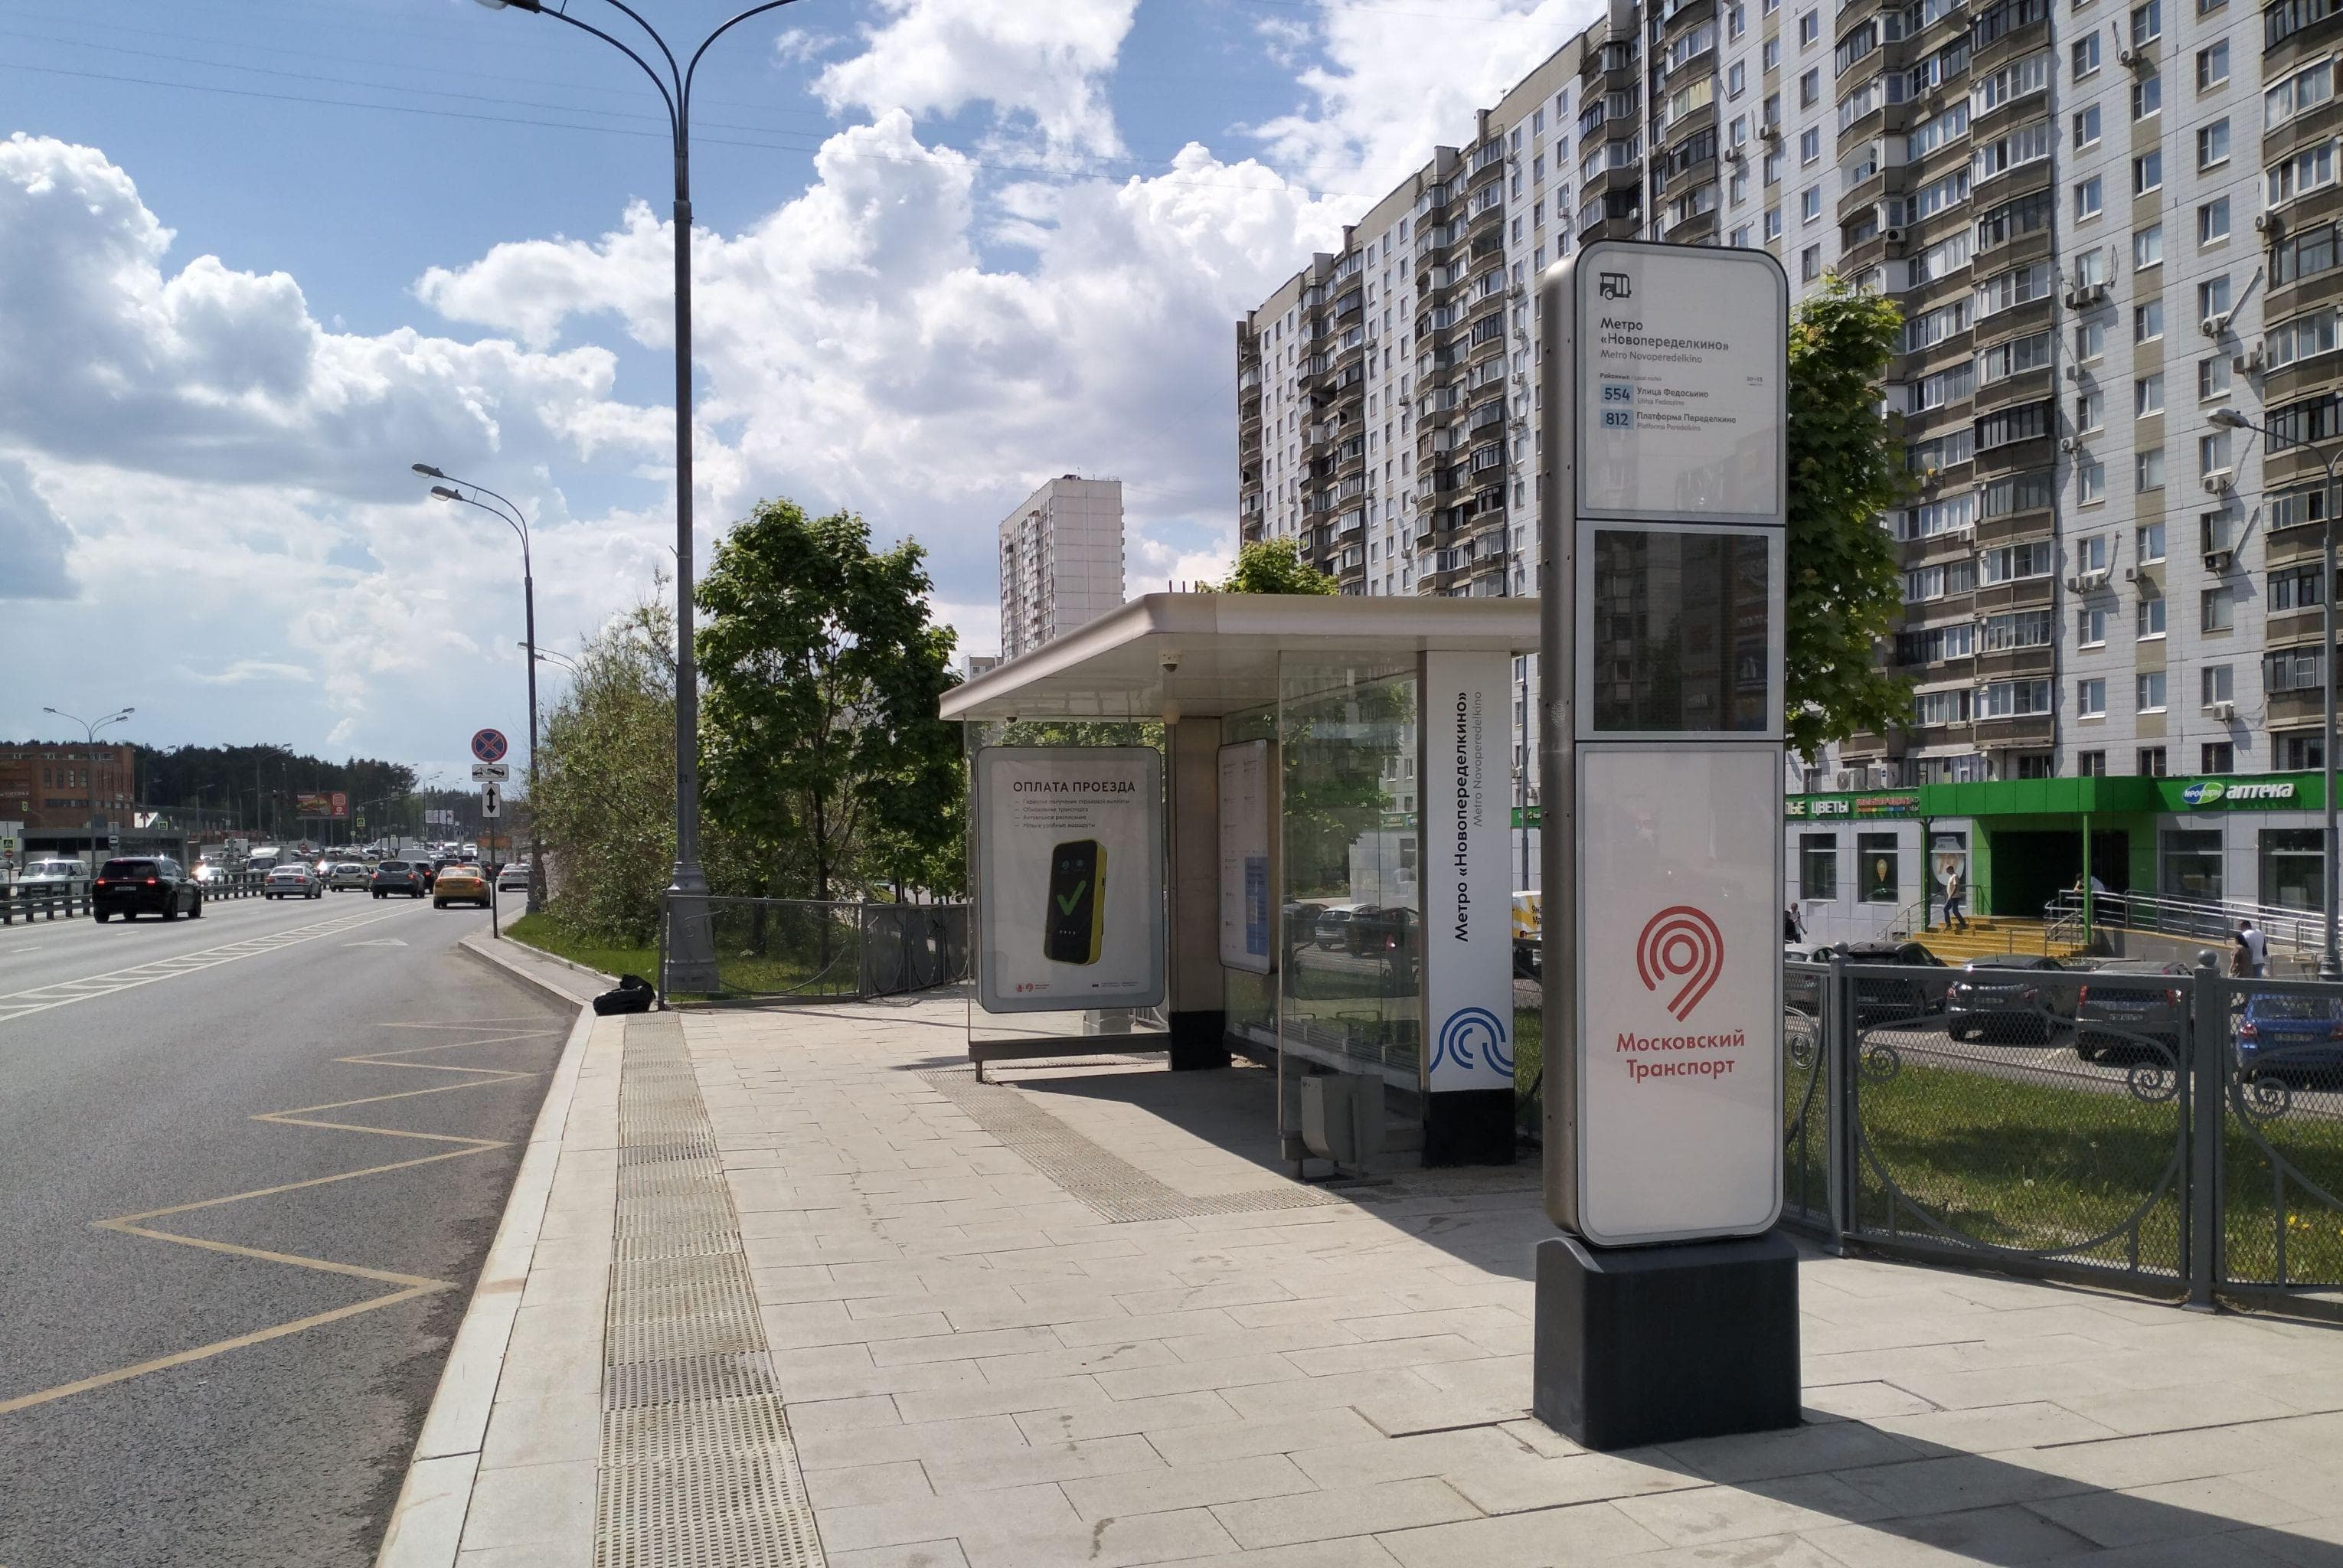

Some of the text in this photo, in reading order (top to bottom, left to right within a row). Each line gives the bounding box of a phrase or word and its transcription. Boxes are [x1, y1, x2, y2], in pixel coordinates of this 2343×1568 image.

[1600, 317, 1643, 332] Метро
[1600, 332, 1729, 351] «Новопеределкино»
[1600, 350, 1702, 363] Metro Novoperedelkino
[1605, 387, 1630, 400] 554
[1637, 387, 1708, 397] Улица Федосьино
[1606, 412, 1629, 426] 812
[1637, 411, 1736, 423] Платформа Переделкино
[1473, 691, 1484, 828] Metro Novoperedelkino
[1013, 781, 1136, 793] ОПЛАТА ПРОЕЗДА
[2227, 783, 2294, 799] аптека
[1812, 800, 1849, 816] ЦВЕТЫ
[1454, 692, 1471, 942] Метро «Новопеределкино»
[1616, 1029, 1745, 1052] Московский
[1626, 1060, 1735, 1083] Транспорт
